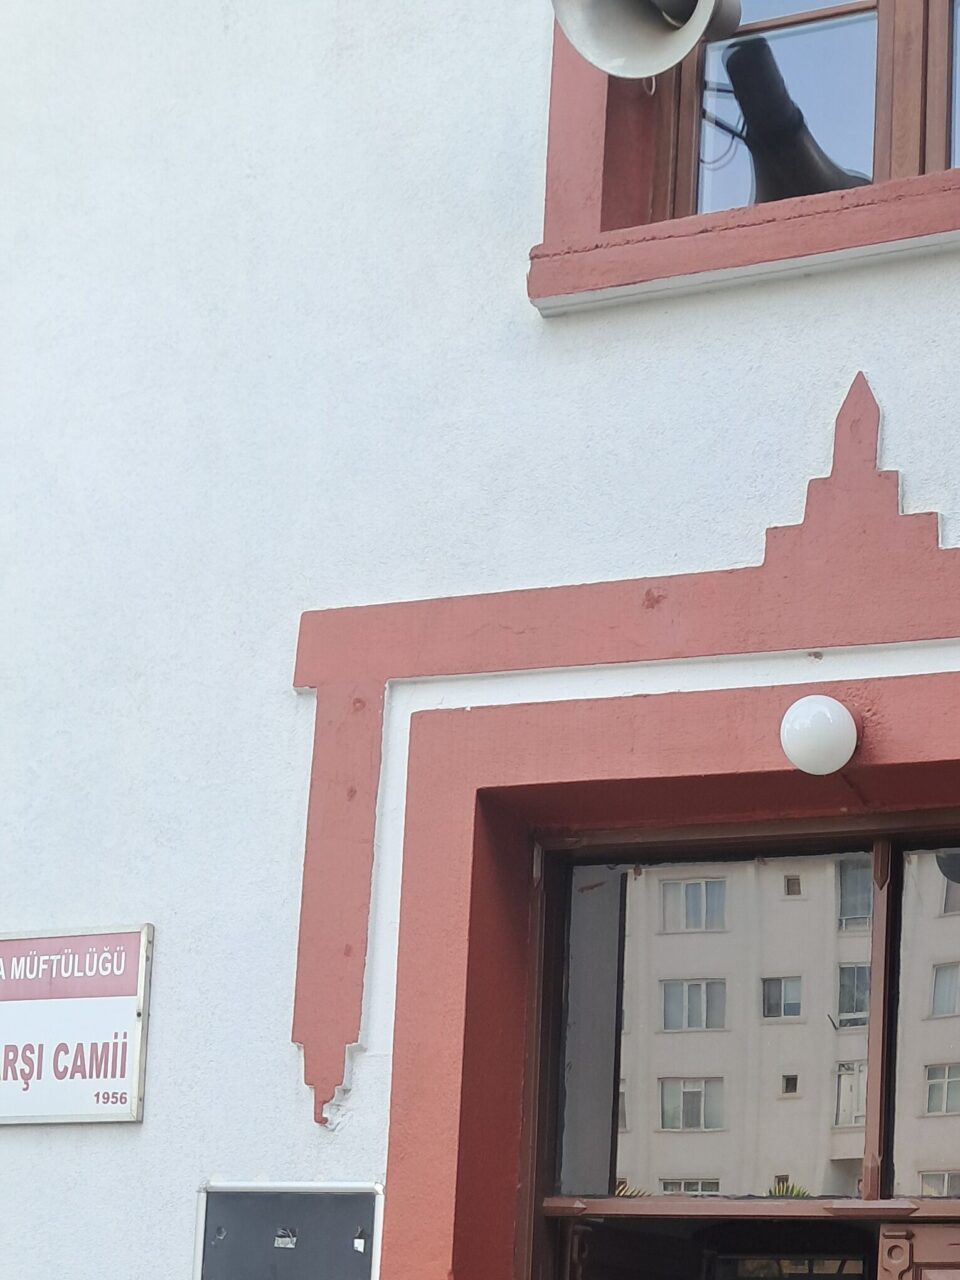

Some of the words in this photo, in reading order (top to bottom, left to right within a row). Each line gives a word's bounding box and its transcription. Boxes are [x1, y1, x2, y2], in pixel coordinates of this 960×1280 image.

[10, 946, 126, 980] MÜFTÜLÜĞÜ
[0, 1043, 44, 1091] RŞI
[53, 1032, 128, 1080] CAMİİ
[94, 1092, 128, 1105] 1956
